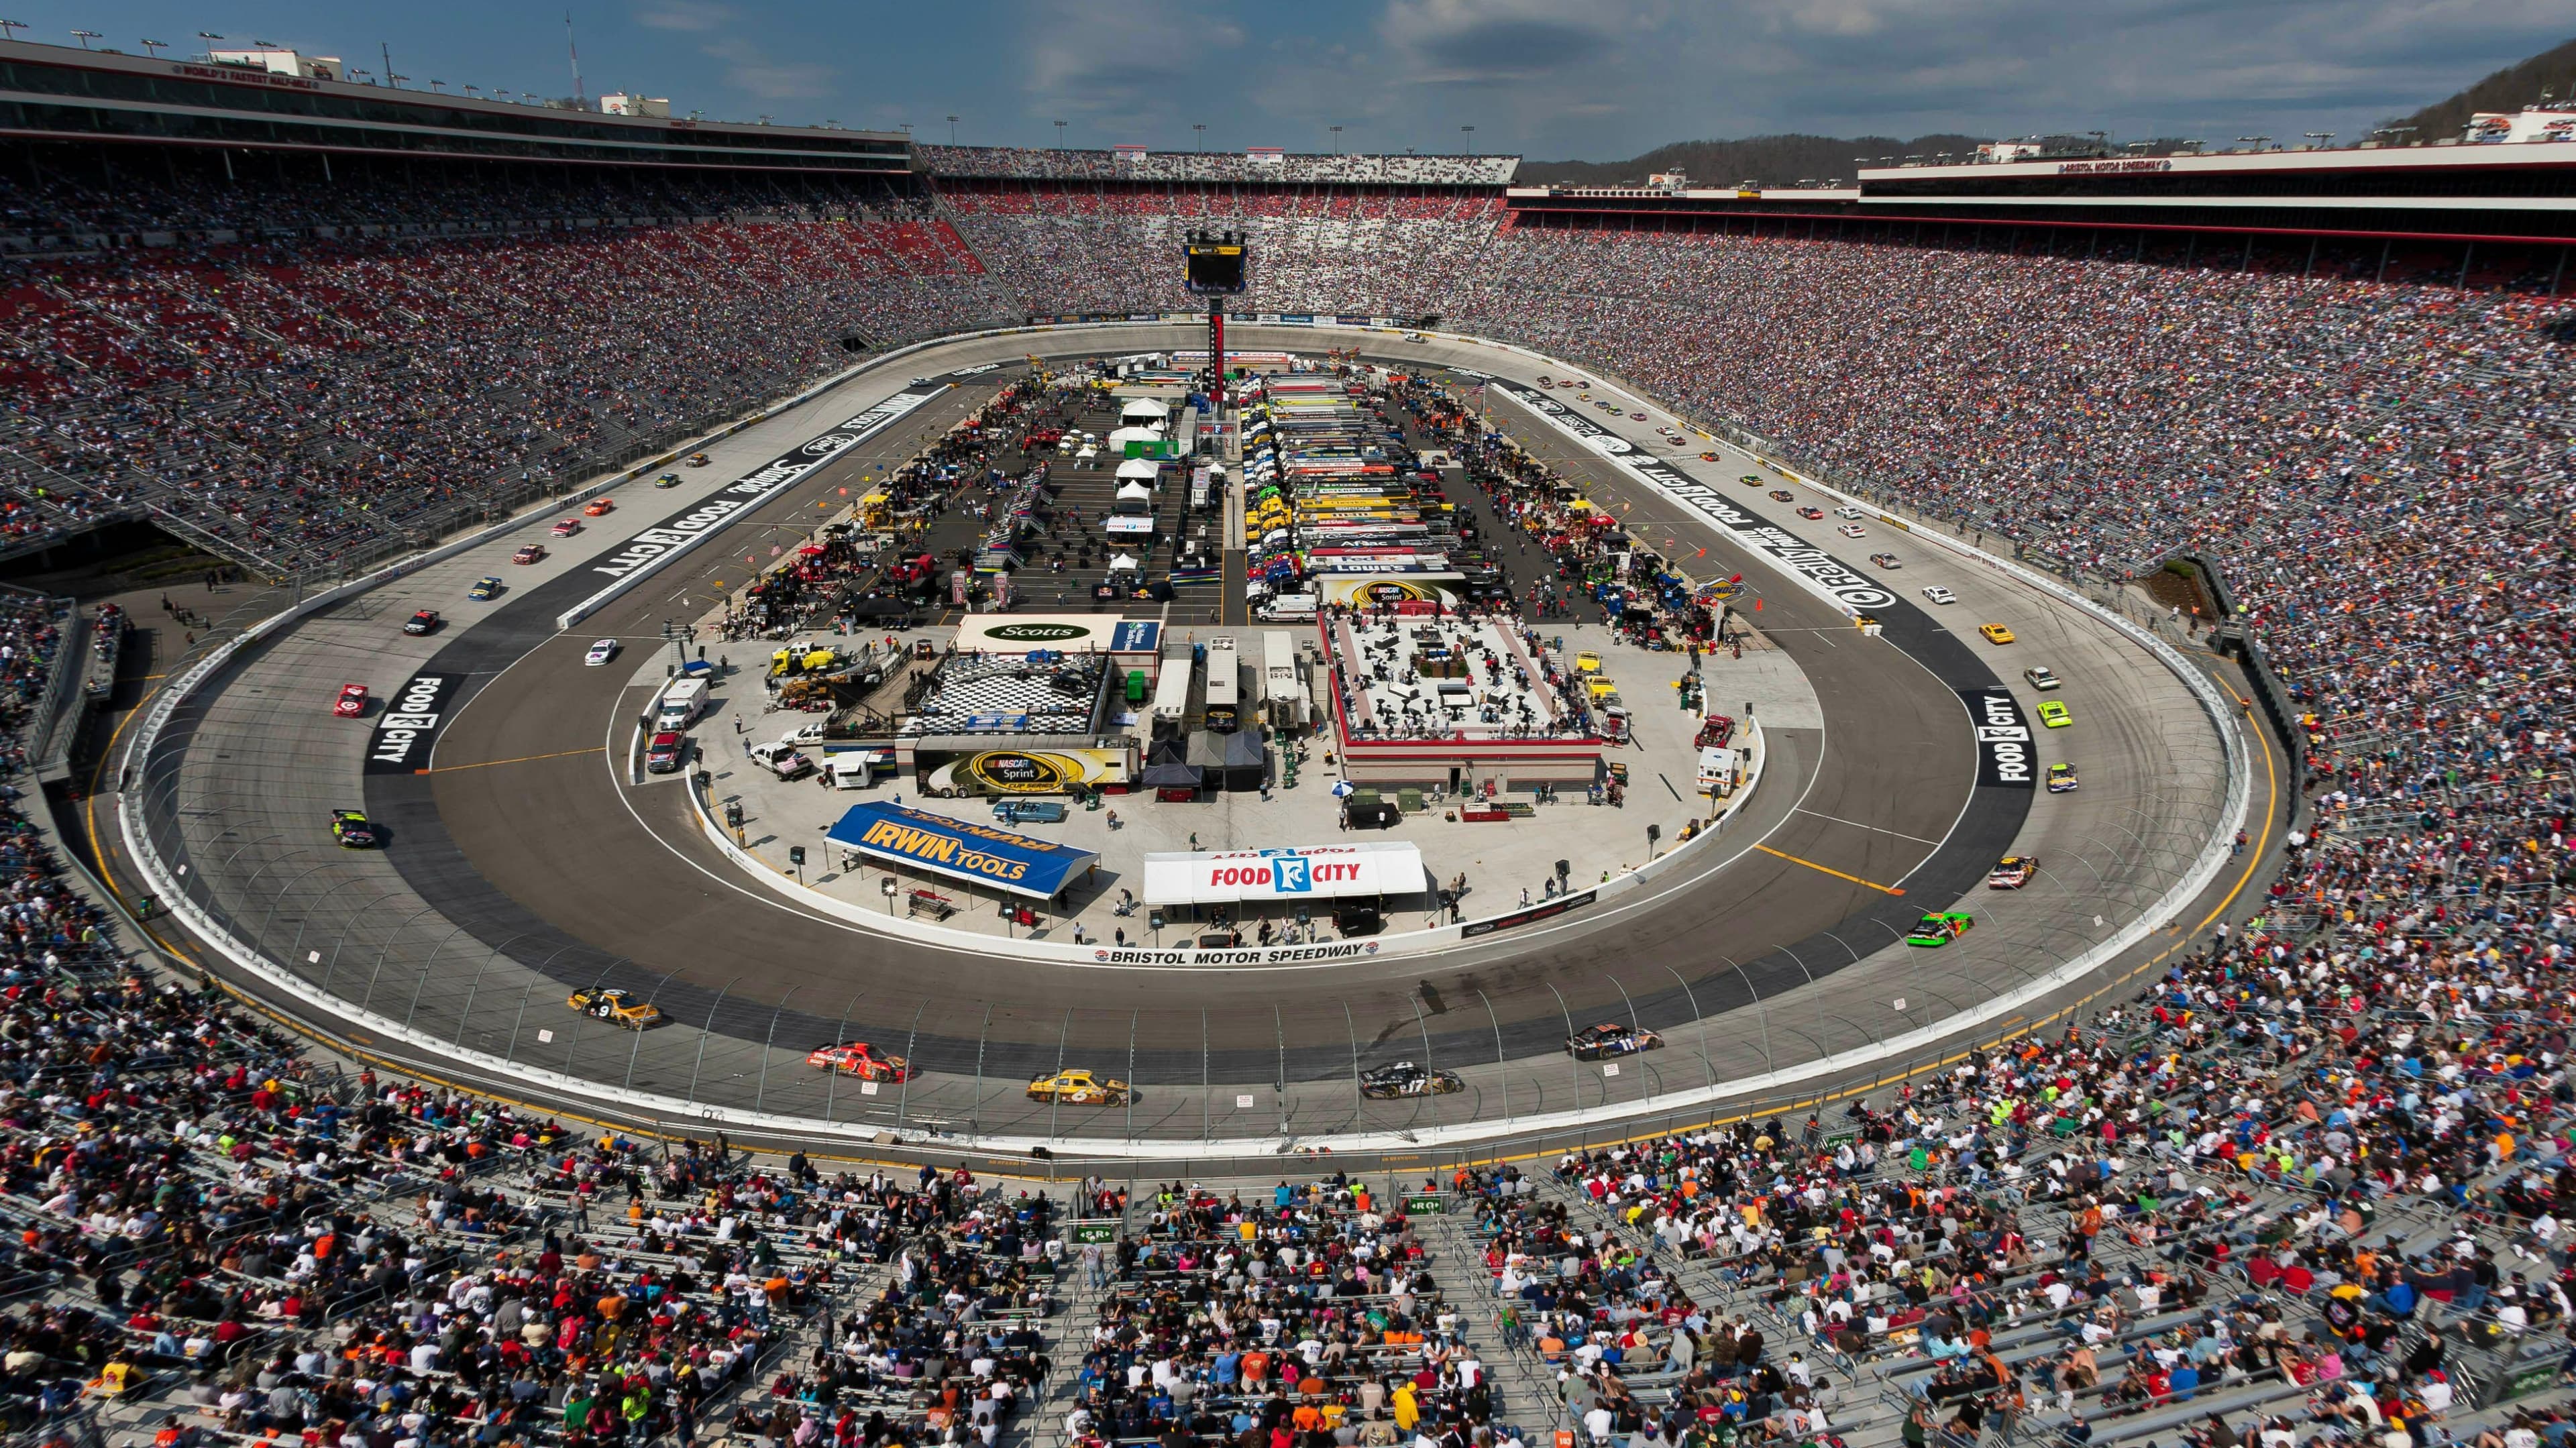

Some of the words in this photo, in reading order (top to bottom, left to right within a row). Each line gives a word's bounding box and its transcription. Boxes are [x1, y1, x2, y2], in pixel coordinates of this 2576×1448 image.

[230, 72, 268, 85] FASTEST
[2094, 162, 2120, 172] MOTOR
[2122, 160, 2162, 171] SPEEDWAY
[841, 412, 885, 429] TOOLS
[1641, 469, 1688, 487] CITY
[673, 500, 743, 529] FOOD
[1690, 497, 1754, 524] FOOD
[1754, 526, 1805, 549] PARTS
[592, 544, 665, 577] CITY
[1702, 586, 1742, 594] SUNOCO
[1000, 626, 1073, 636] Scotts
[400, 677, 443, 713] FOOD
[1987, 696, 2012, 725] CITY
[373, 728, 417, 763] CITY
[998, 759, 1029, 768] NASCAR
[1995, 742, 2030, 782] FOOD
[1004, 769, 1034, 779] Sprint
[861, 821, 959, 862] IRWIN
[953, 850, 1026, 880] TOOLS
[1297, 847, 1356, 855] FOOD
[1211, 867, 1272, 887] FOOD
[1312, 863, 1361, 883] CITY
[1110, 951, 1187, 964] BRISTOL
[1194, 951, 1262, 964] MOTOR
[1267, 942, 1364, 962] SPEEDWAY
[598, 1005, 609, 1017] 9
[1619, 1038, 1635, 1051] 11
[814, 1052, 847, 1064] TRACKER
[852, 1062, 861, 1075] 1
[1408, 1079, 1426, 1093] 17
[1071, 1089, 1087, 1101] 6
[1095, 1230, 1104, 1238] R
